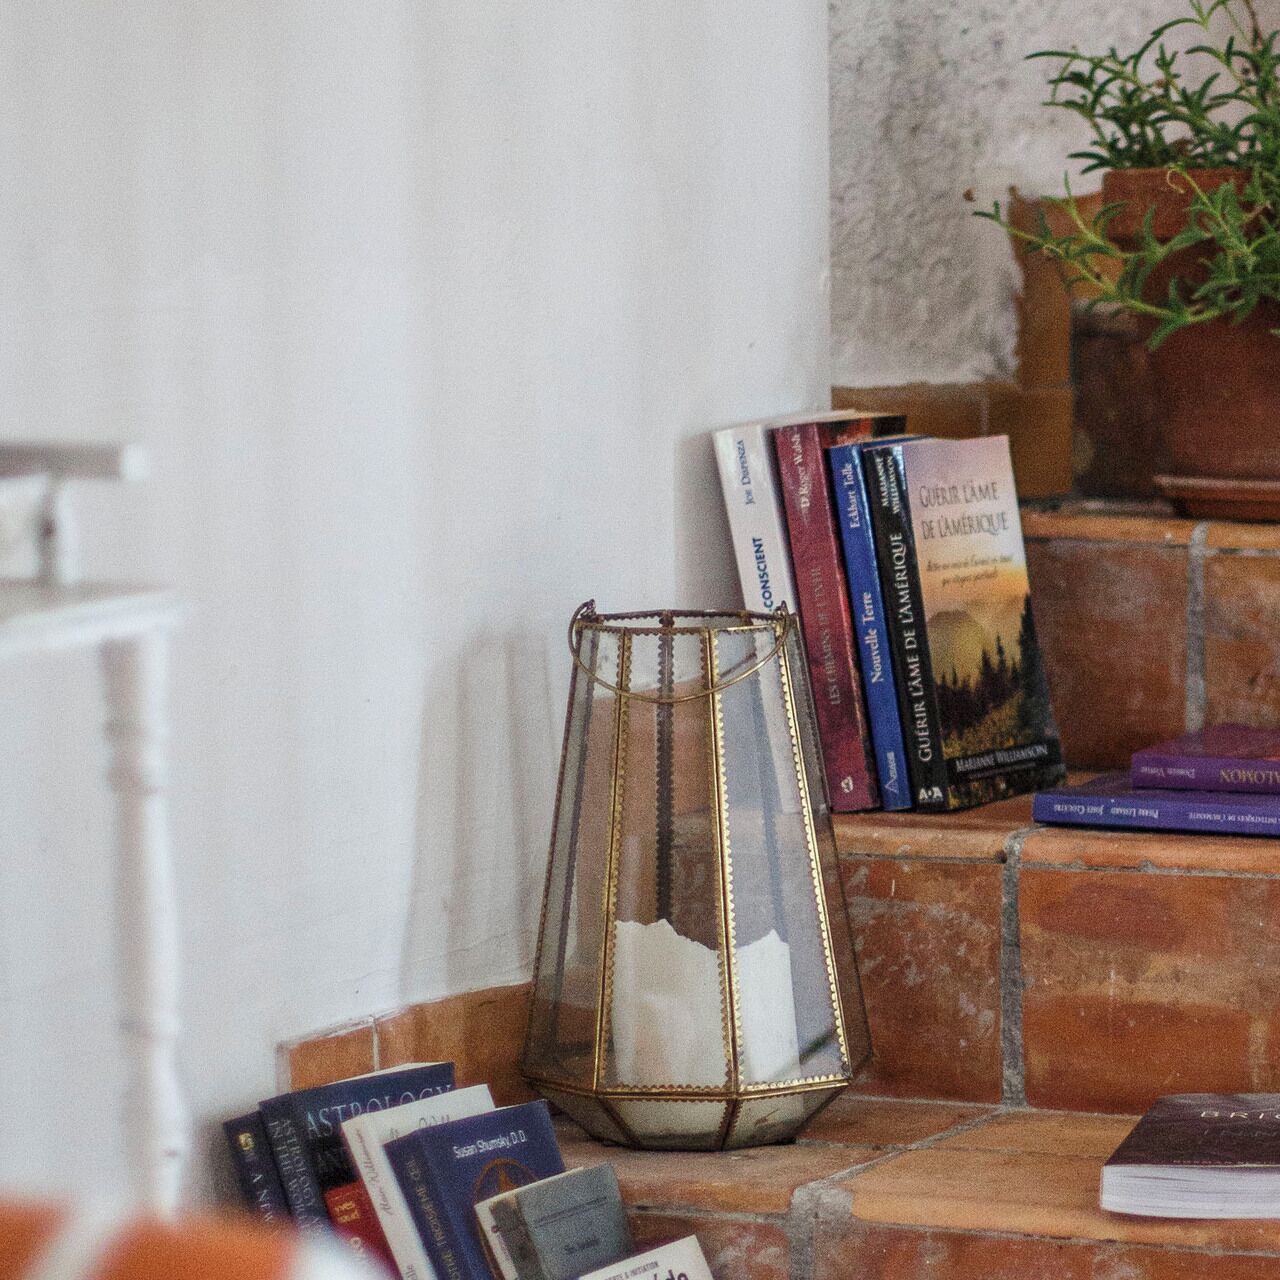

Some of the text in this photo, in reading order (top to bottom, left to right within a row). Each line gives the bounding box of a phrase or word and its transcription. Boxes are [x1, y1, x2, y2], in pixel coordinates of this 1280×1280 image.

[839, 461, 861, 529] Eckhart Tolle
[874, 456, 889, 507] MARIANNE
[884, 455, 901, 514] WILLIAMSON
[922, 520, 935, 540] DE
[886, 531, 915, 623] L'AMÉRIQUE
[857, 591, 884, 683] Nouvelle Terre
[902, 628, 917, 649] DE
[904, 654, 924, 697] L'ÂME
[911, 700, 933, 762] GUÉRIR
[452, 1142, 477, 1160] Susan
